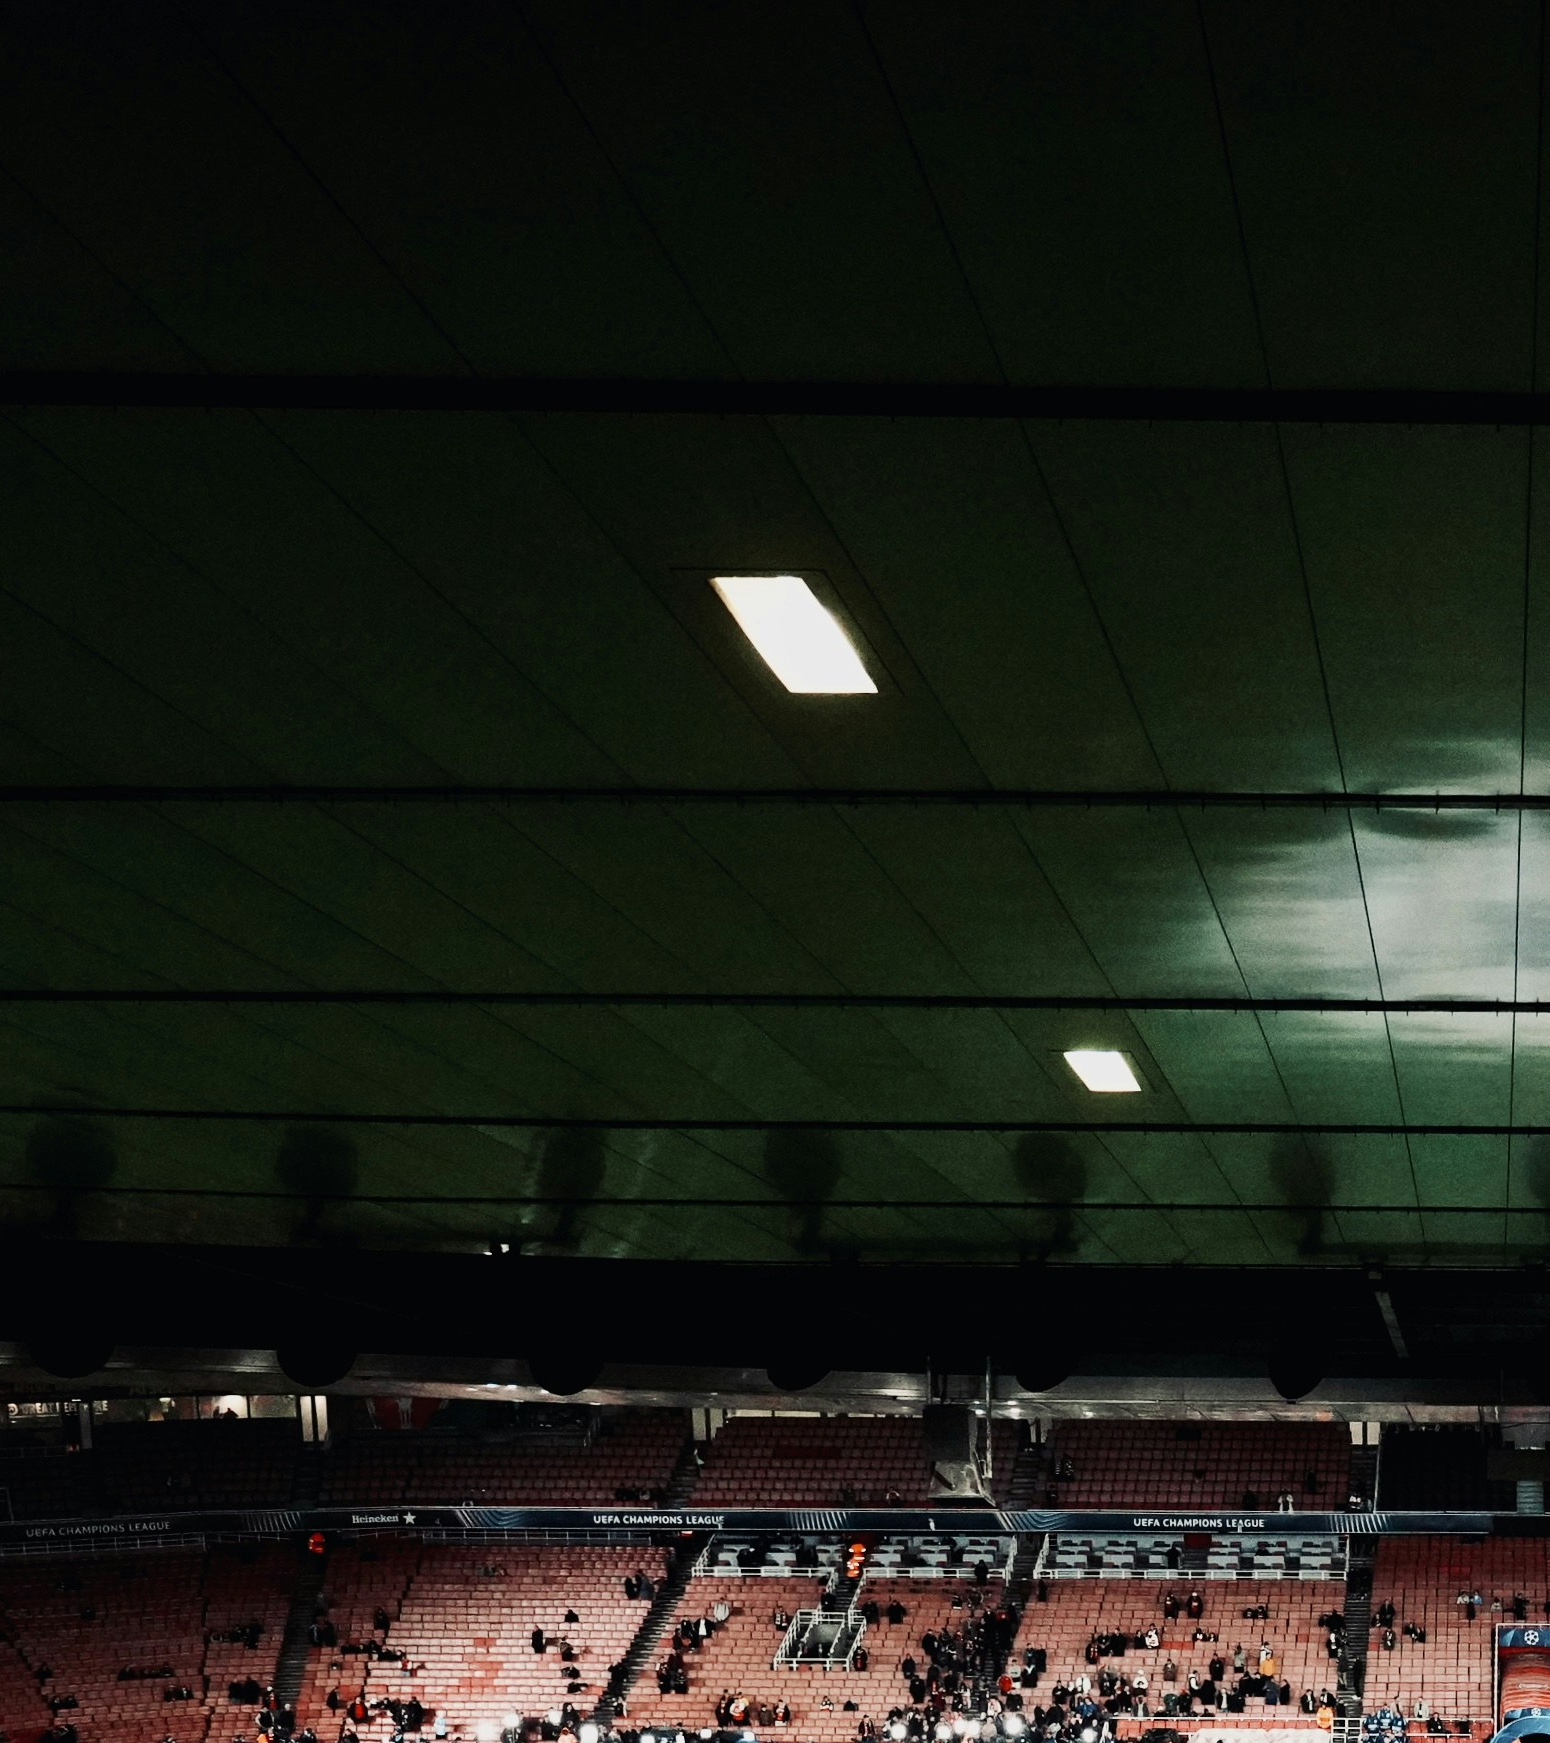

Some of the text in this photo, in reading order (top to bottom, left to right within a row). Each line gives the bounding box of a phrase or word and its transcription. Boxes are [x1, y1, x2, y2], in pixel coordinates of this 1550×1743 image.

[352, 1514, 399, 1524] Heineken
[593, 1515, 621, 1525] UEFA
[623, 1515, 683, 1525] CHAMPIONS
[1133, 1518, 1161, 1527] UEFA
[1163, 1518, 1223, 1528] CHAMPIONS
[26, 1521, 171, 1538] UEFA CHAMPIONS LEAGUE
